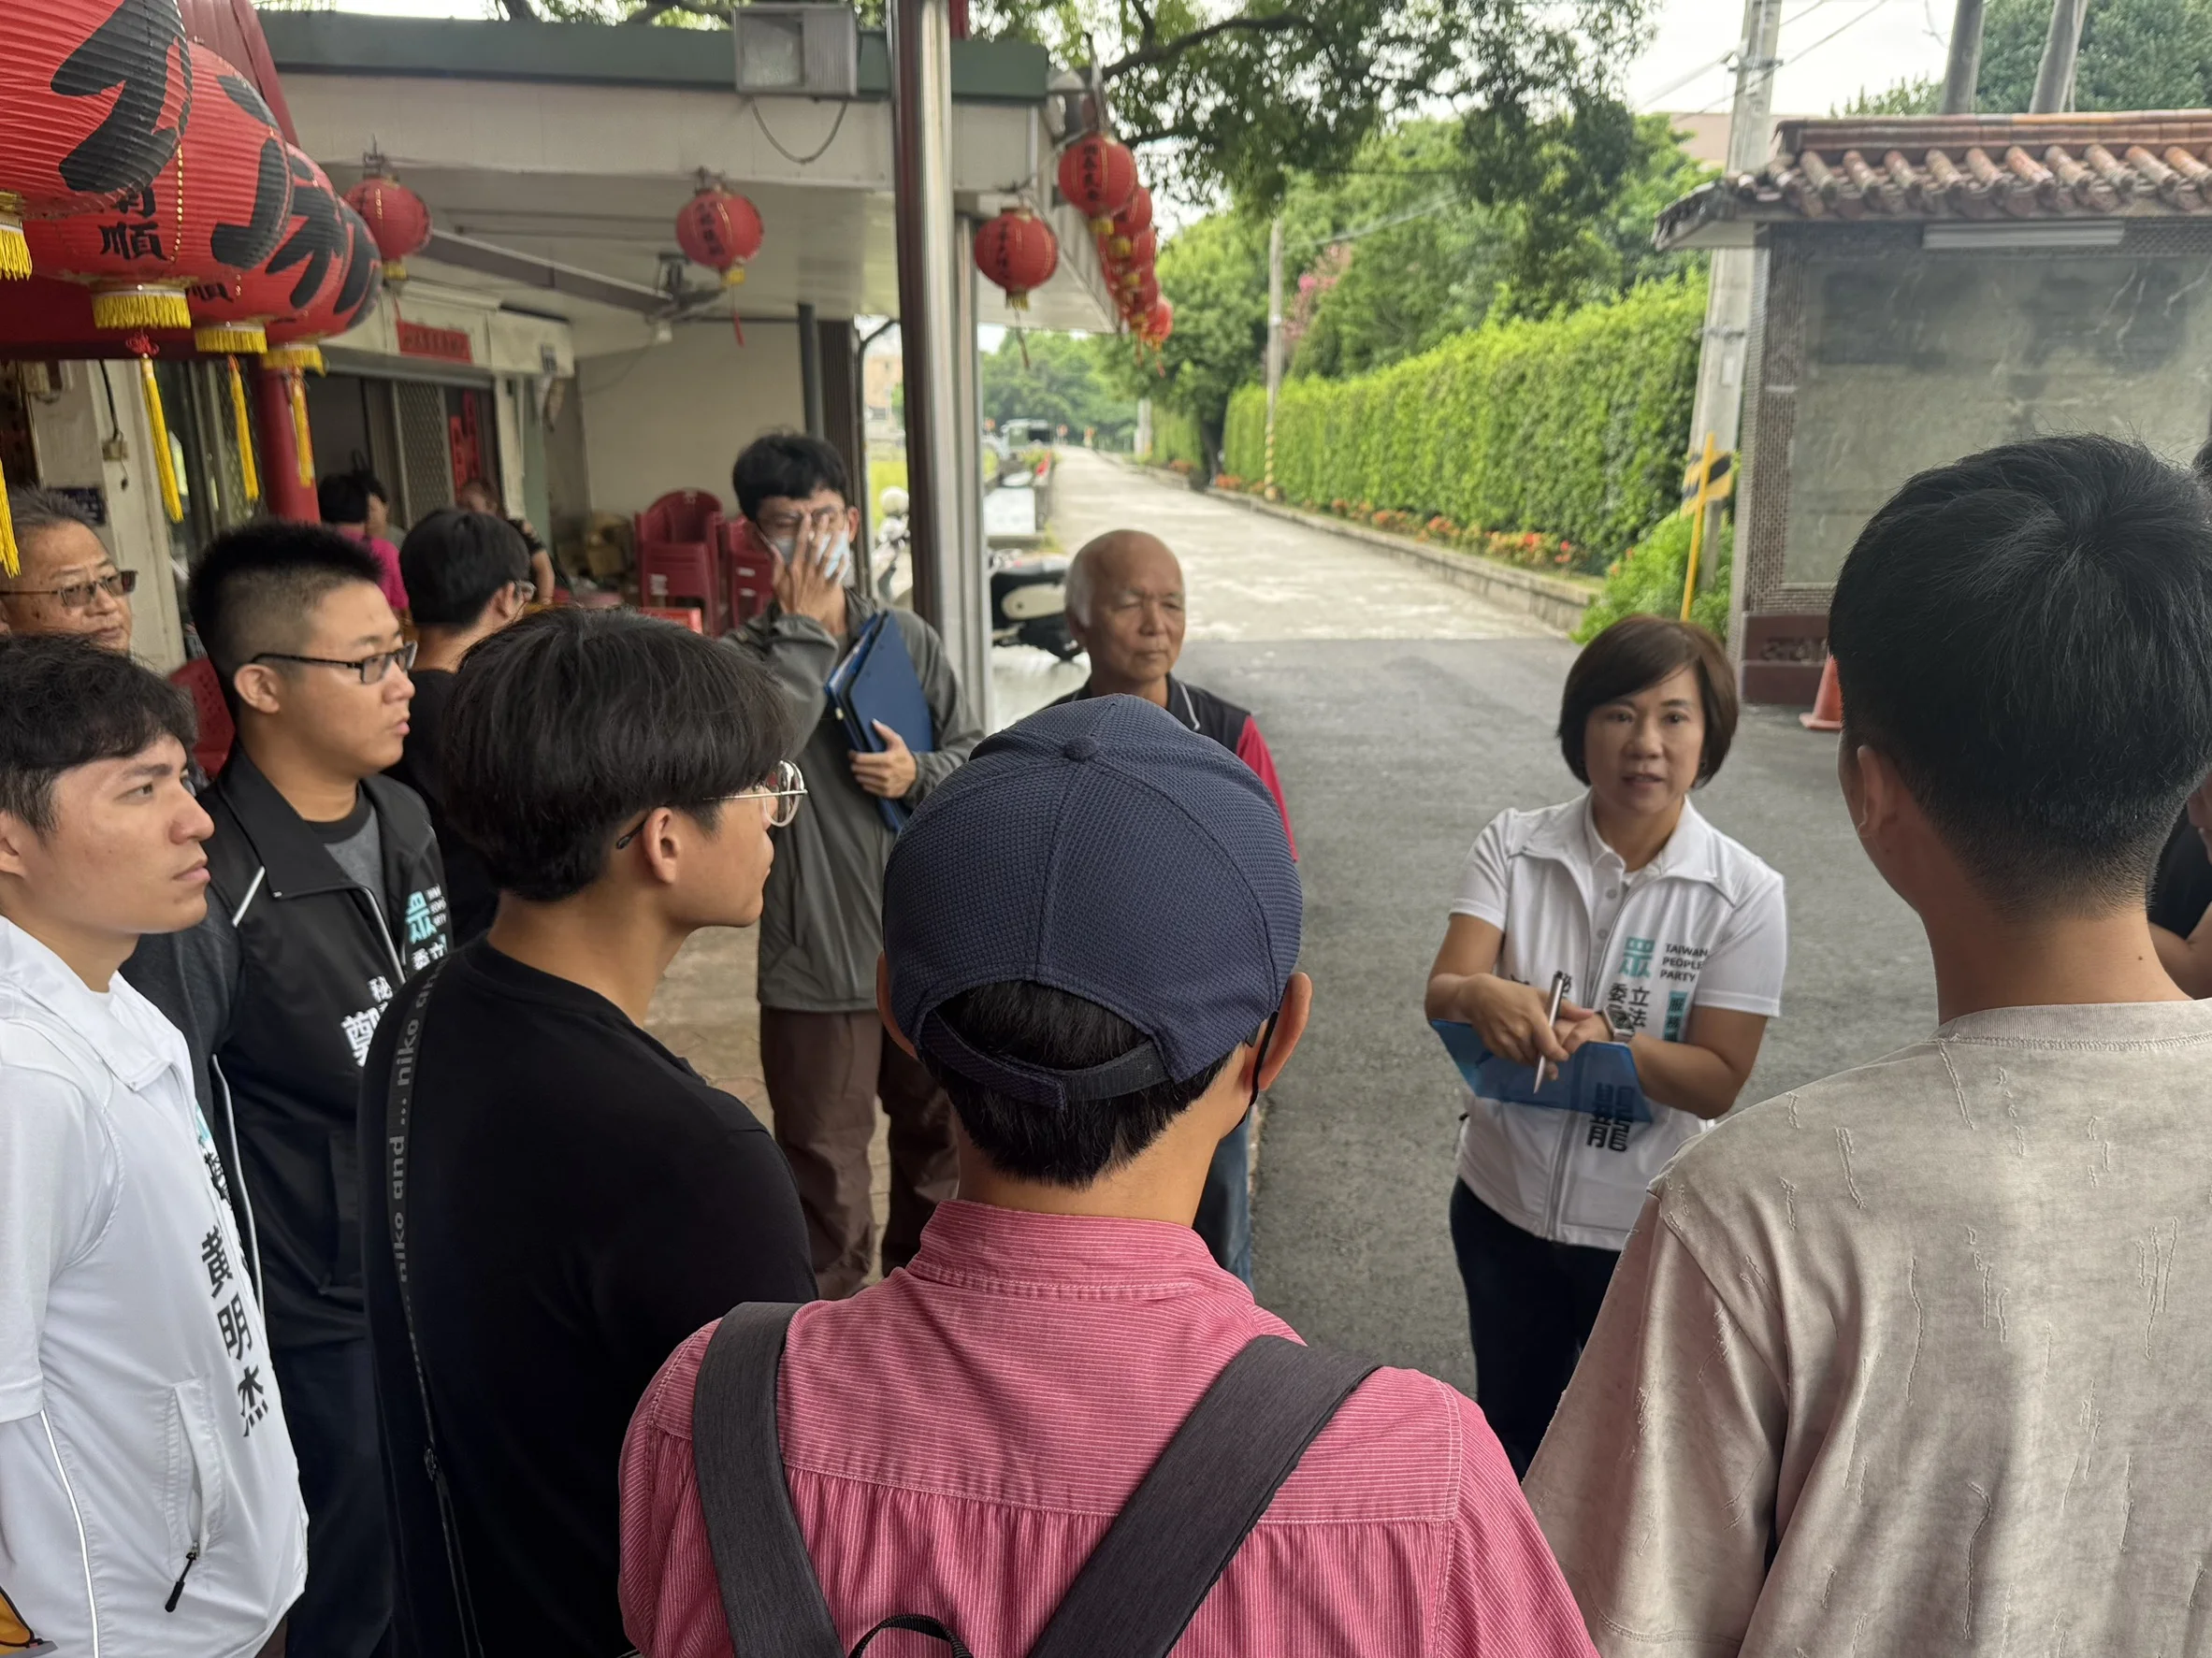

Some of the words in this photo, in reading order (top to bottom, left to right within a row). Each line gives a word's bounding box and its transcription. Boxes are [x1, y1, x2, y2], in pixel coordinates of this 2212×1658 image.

[1618, 936, 1655, 978] 眾
[1659, 969, 1697, 982] PARTY
[1665, 943, 1709, 957] TAIWAN
[397, 1018, 420, 1087] niko
[388, 1134, 406, 1201] and
[392, 1212, 408, 1283] niko
